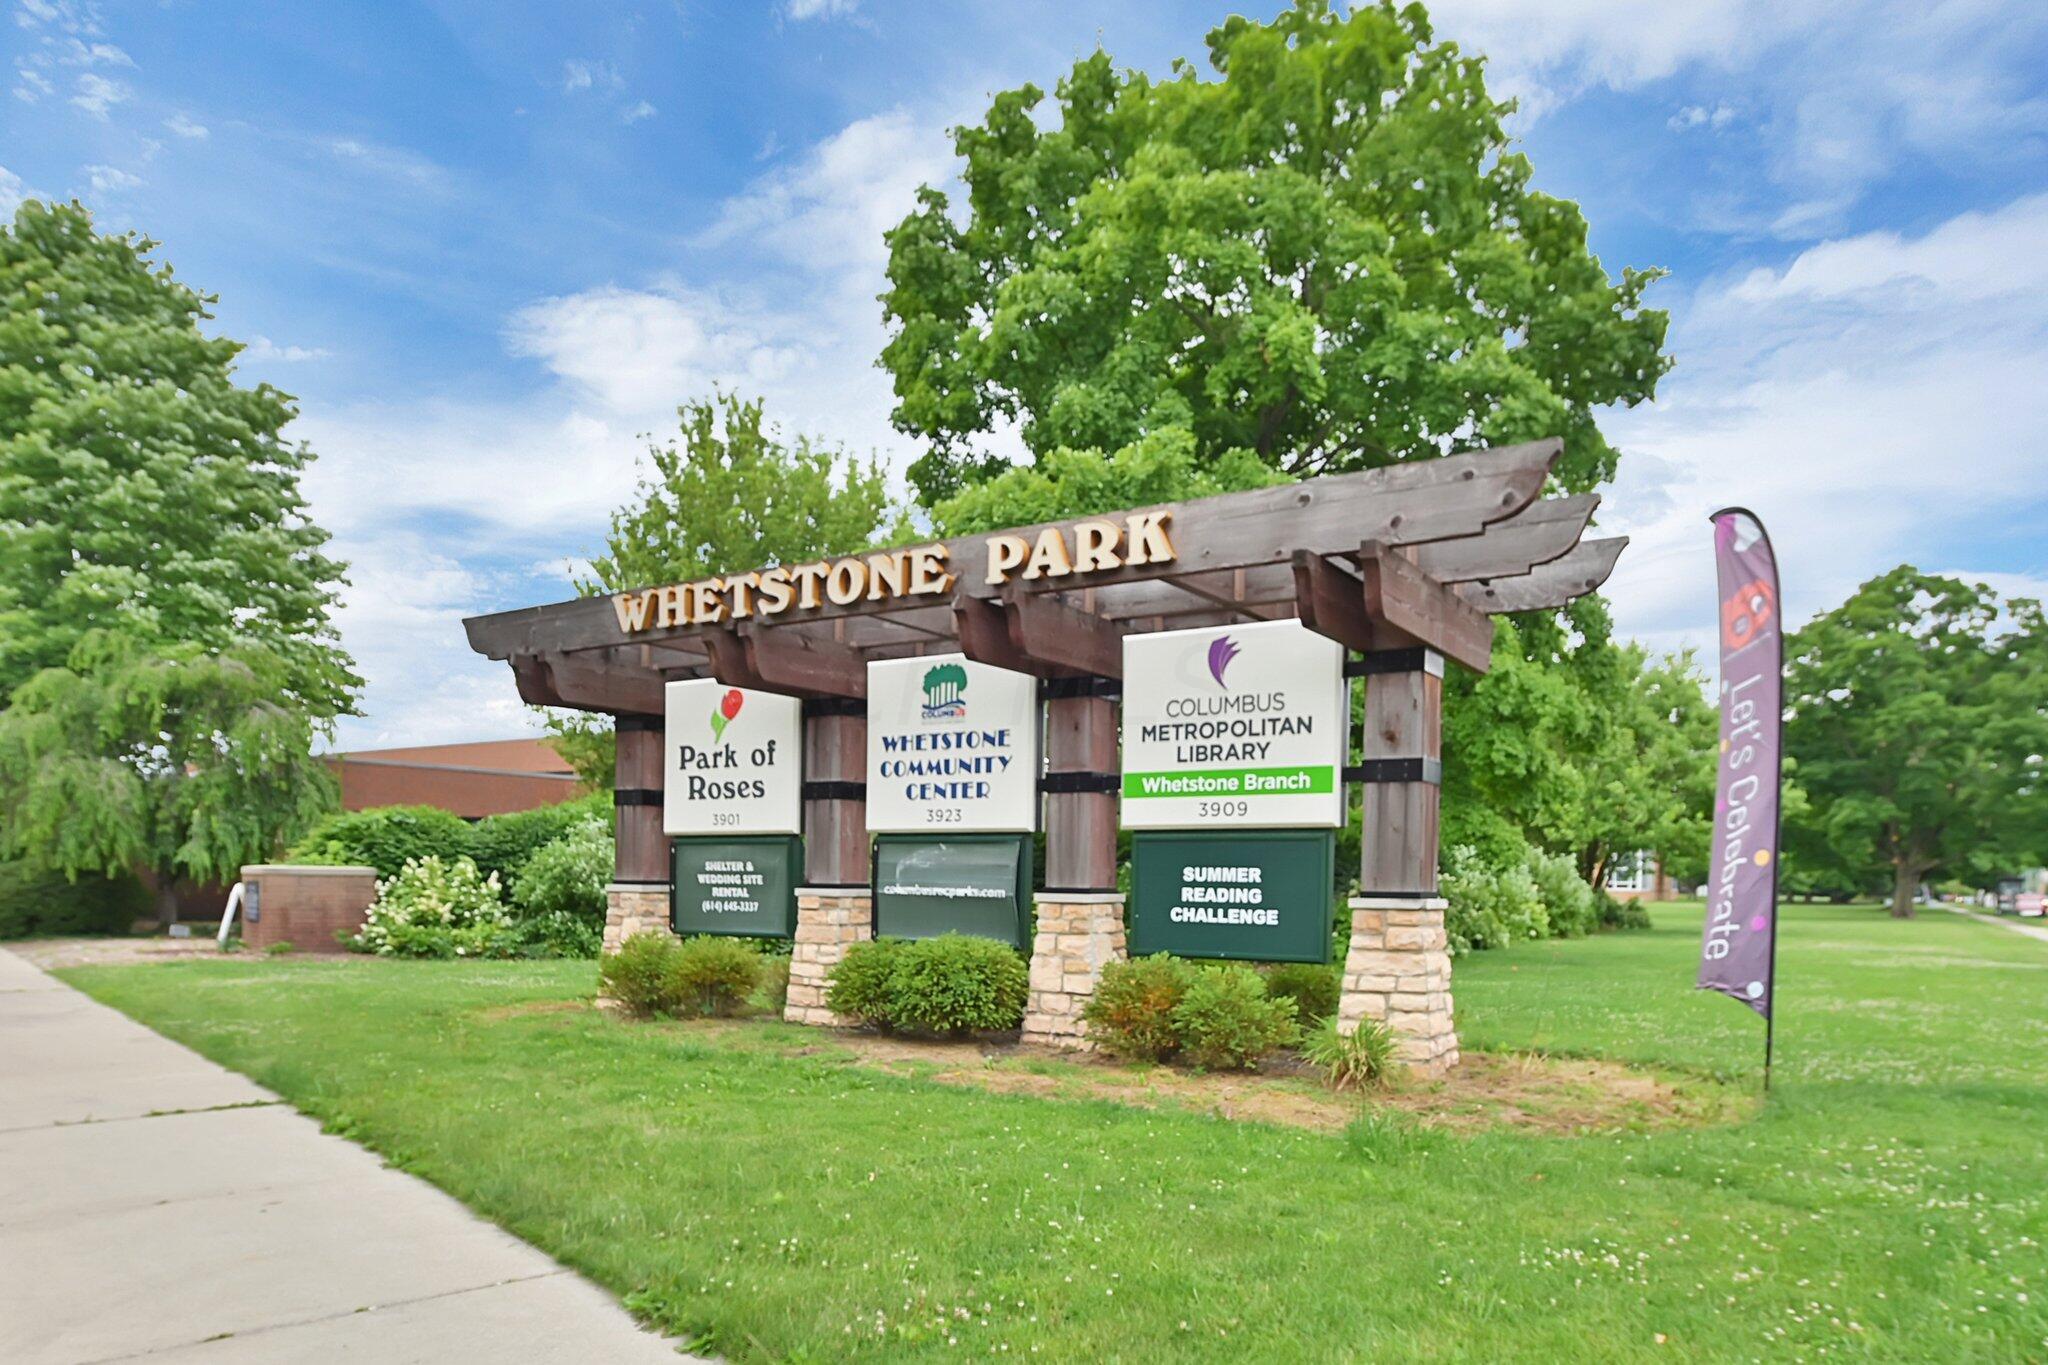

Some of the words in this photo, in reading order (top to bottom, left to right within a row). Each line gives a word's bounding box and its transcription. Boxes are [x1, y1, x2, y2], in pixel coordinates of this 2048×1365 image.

[613, 543, 954, 633] WHETSTONE
[984, 510, 1178, 585] PARK
[1166, 692, 1285, 717] COLUMBUS
[1142, 716, 1312, 742] METROPOLITAN
[1729, 674, 1763, 770] Let's
[882, 729, 1011, 752] WHETSTONE
[679, 743, 738, 770] Park
[751, 739, 776, 766] of
[1177, 742, 1270, 762] LIBRARY
[880, 756, 1013, 778] COMMUNITY
[688, 775, 766, 800] Roses
[905, 782, 991, 800] CENTER
[1141, 776, 1239, 793] Whetstone
[1244, 772, 1311, 791] Branch
[712, 813, 741, 826] 3901
[926, 809, 961, 822] 3923
[1199, 802, 1248, 817] 3909
[704, 861, 745, 871] SHELTER
[745, 861, 754, 871] &
[1183, 867, 1262, 883] SUMMER
[1704, 775, 1759, 960] Celebrate
[697, 874, 741, 884] WEDDING
[742, 874, 764, 885] SITE
[711, 887, 749, 897] RENTAL
[1181, 887, 1263, 904] READING
[1170, 907, 1279, 925] CHALLENGE
